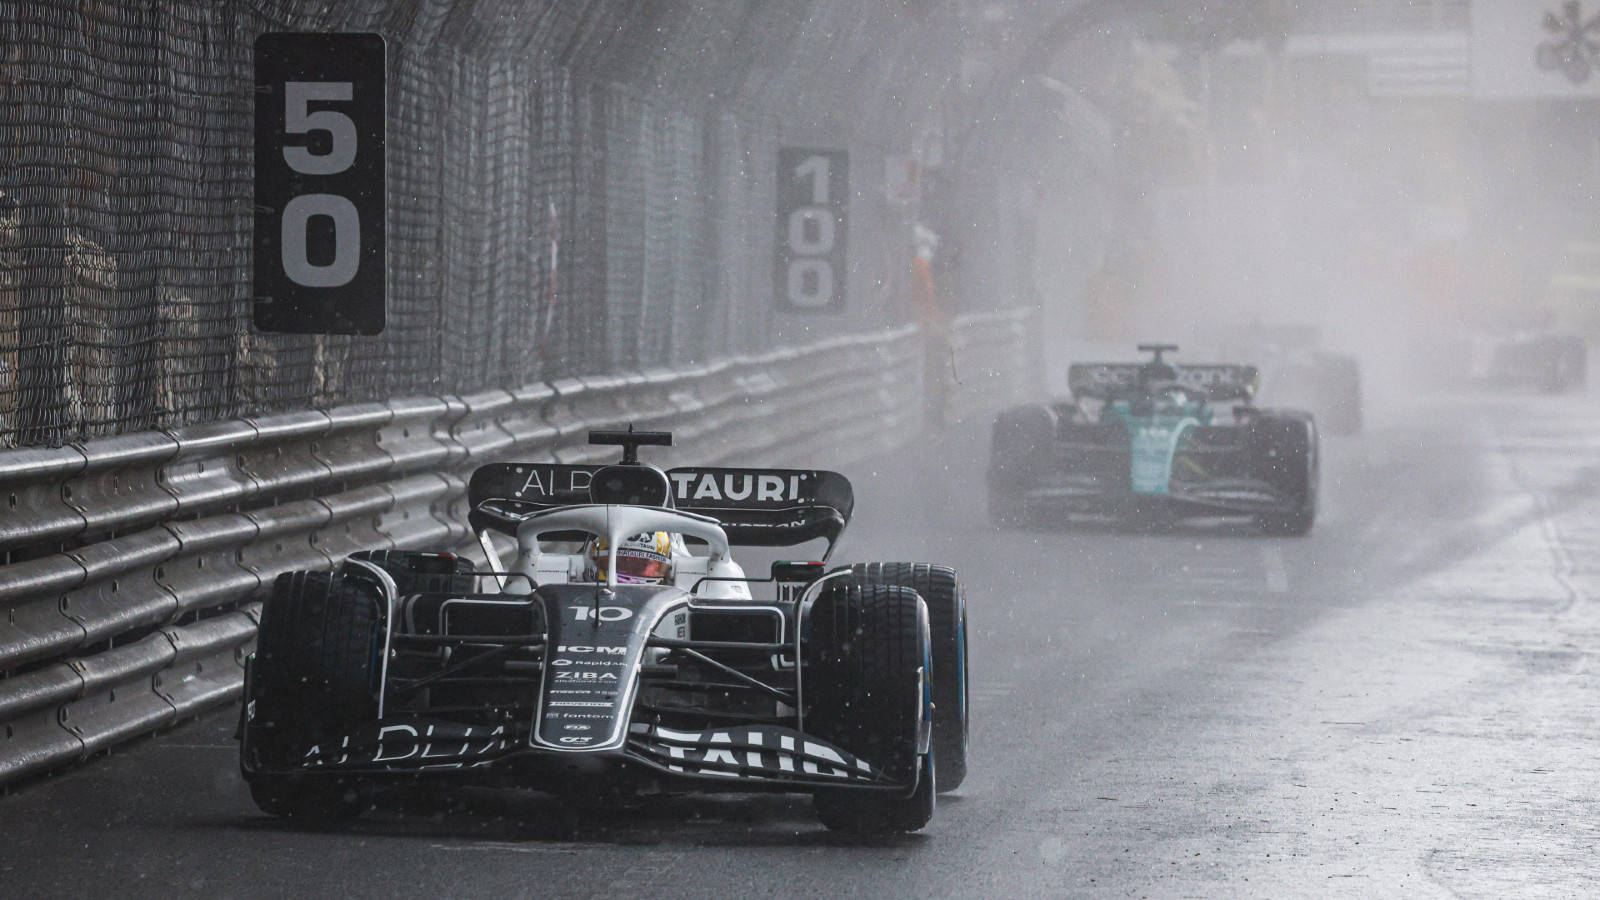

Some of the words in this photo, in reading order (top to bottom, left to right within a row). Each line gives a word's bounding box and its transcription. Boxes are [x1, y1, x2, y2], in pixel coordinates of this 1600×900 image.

[281, 81, 361, 288] 50
[788, 156, 835, 307] 100
[670, 473, 798, 501] TAURI
[568, 606, 633, 622] 10
[557, 645, 627, 655] ICM
[556, 671, 618, 680] ZIBA
